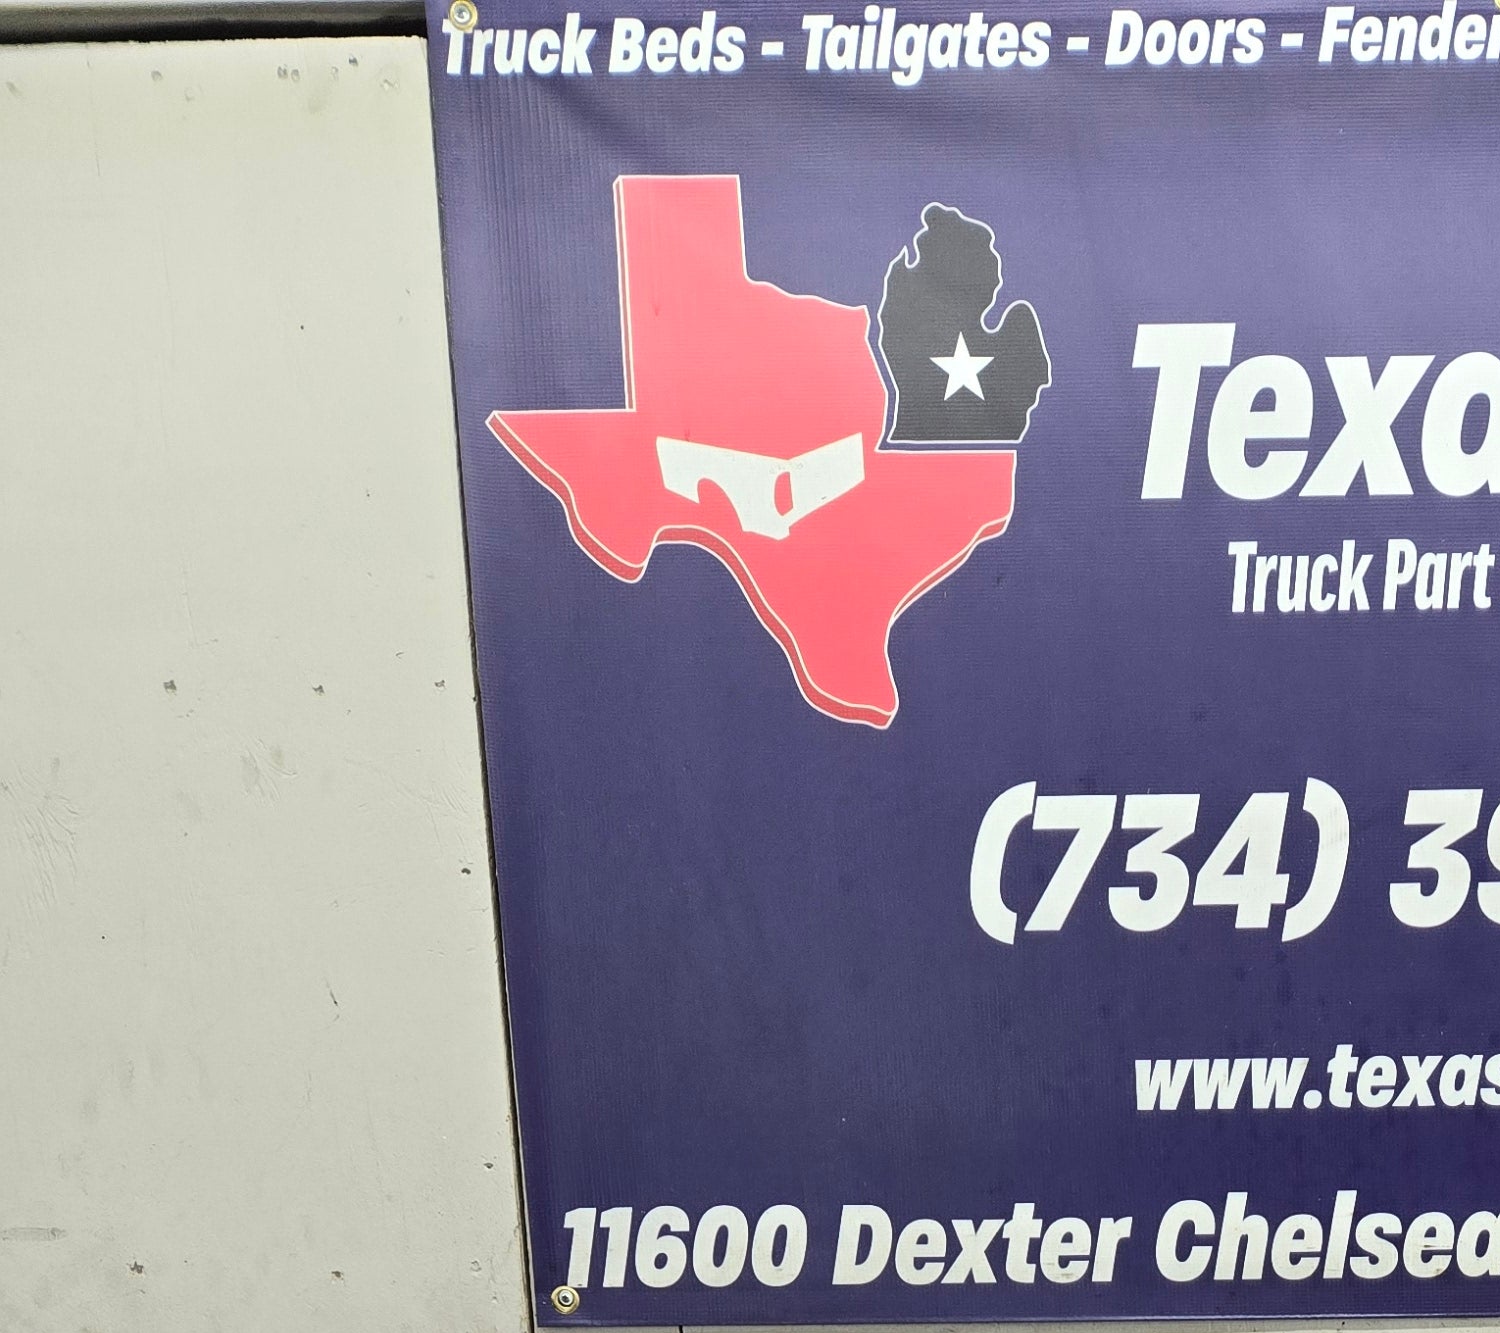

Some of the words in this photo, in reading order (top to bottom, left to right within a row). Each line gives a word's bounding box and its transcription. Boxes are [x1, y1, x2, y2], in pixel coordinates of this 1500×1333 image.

[441, 11, 597, 76] Truck
[608, 10, 746, 75] Beds
[801, 4, 1052, 88] Tailgates
[1104, 9, 1267, 67] Doors
[1227, 535, 1374, 613] Truck
[1382, 538, 1496, 612] Part
[969, 777, 1350, 945] (734)
[562, 1204, 808, 1289] 11600
[831, 1200, 1133, 1286] Dexter
